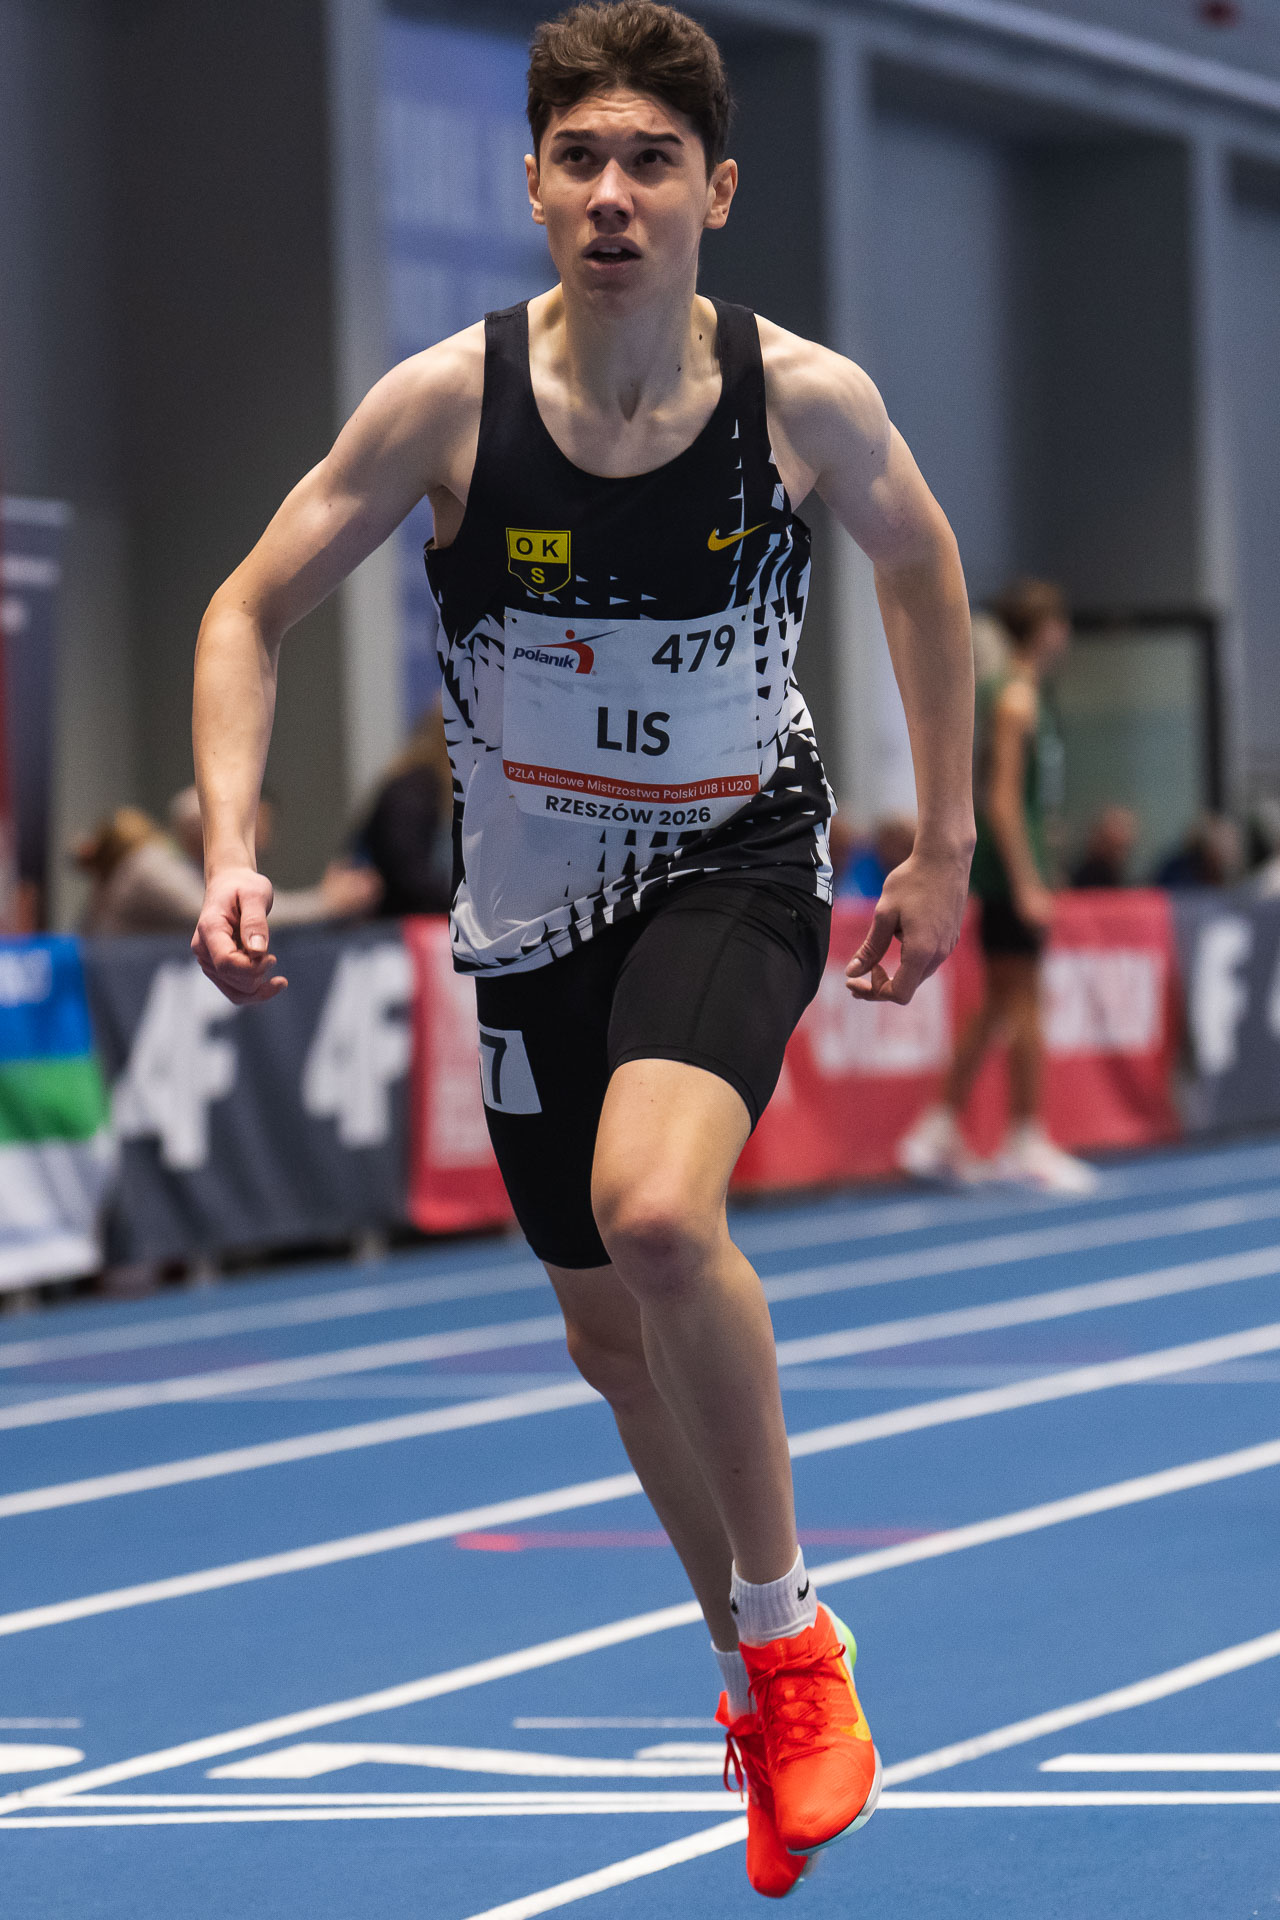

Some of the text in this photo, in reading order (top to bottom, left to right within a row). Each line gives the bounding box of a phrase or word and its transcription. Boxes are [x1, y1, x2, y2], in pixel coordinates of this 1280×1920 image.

[531, 567, 545, 584] S
[512, 646, 576, 669] polanik
[651, 624, 736, 674] 479
[597, 706, 671, 757] LIS
[508, 766, 752, 799] PZLA Halowe Mistrzostwa Polski U18 i U20
[545, 795, 712, 826] RZESZÓW 2026
[480, 1030, 508, 1105] 7
